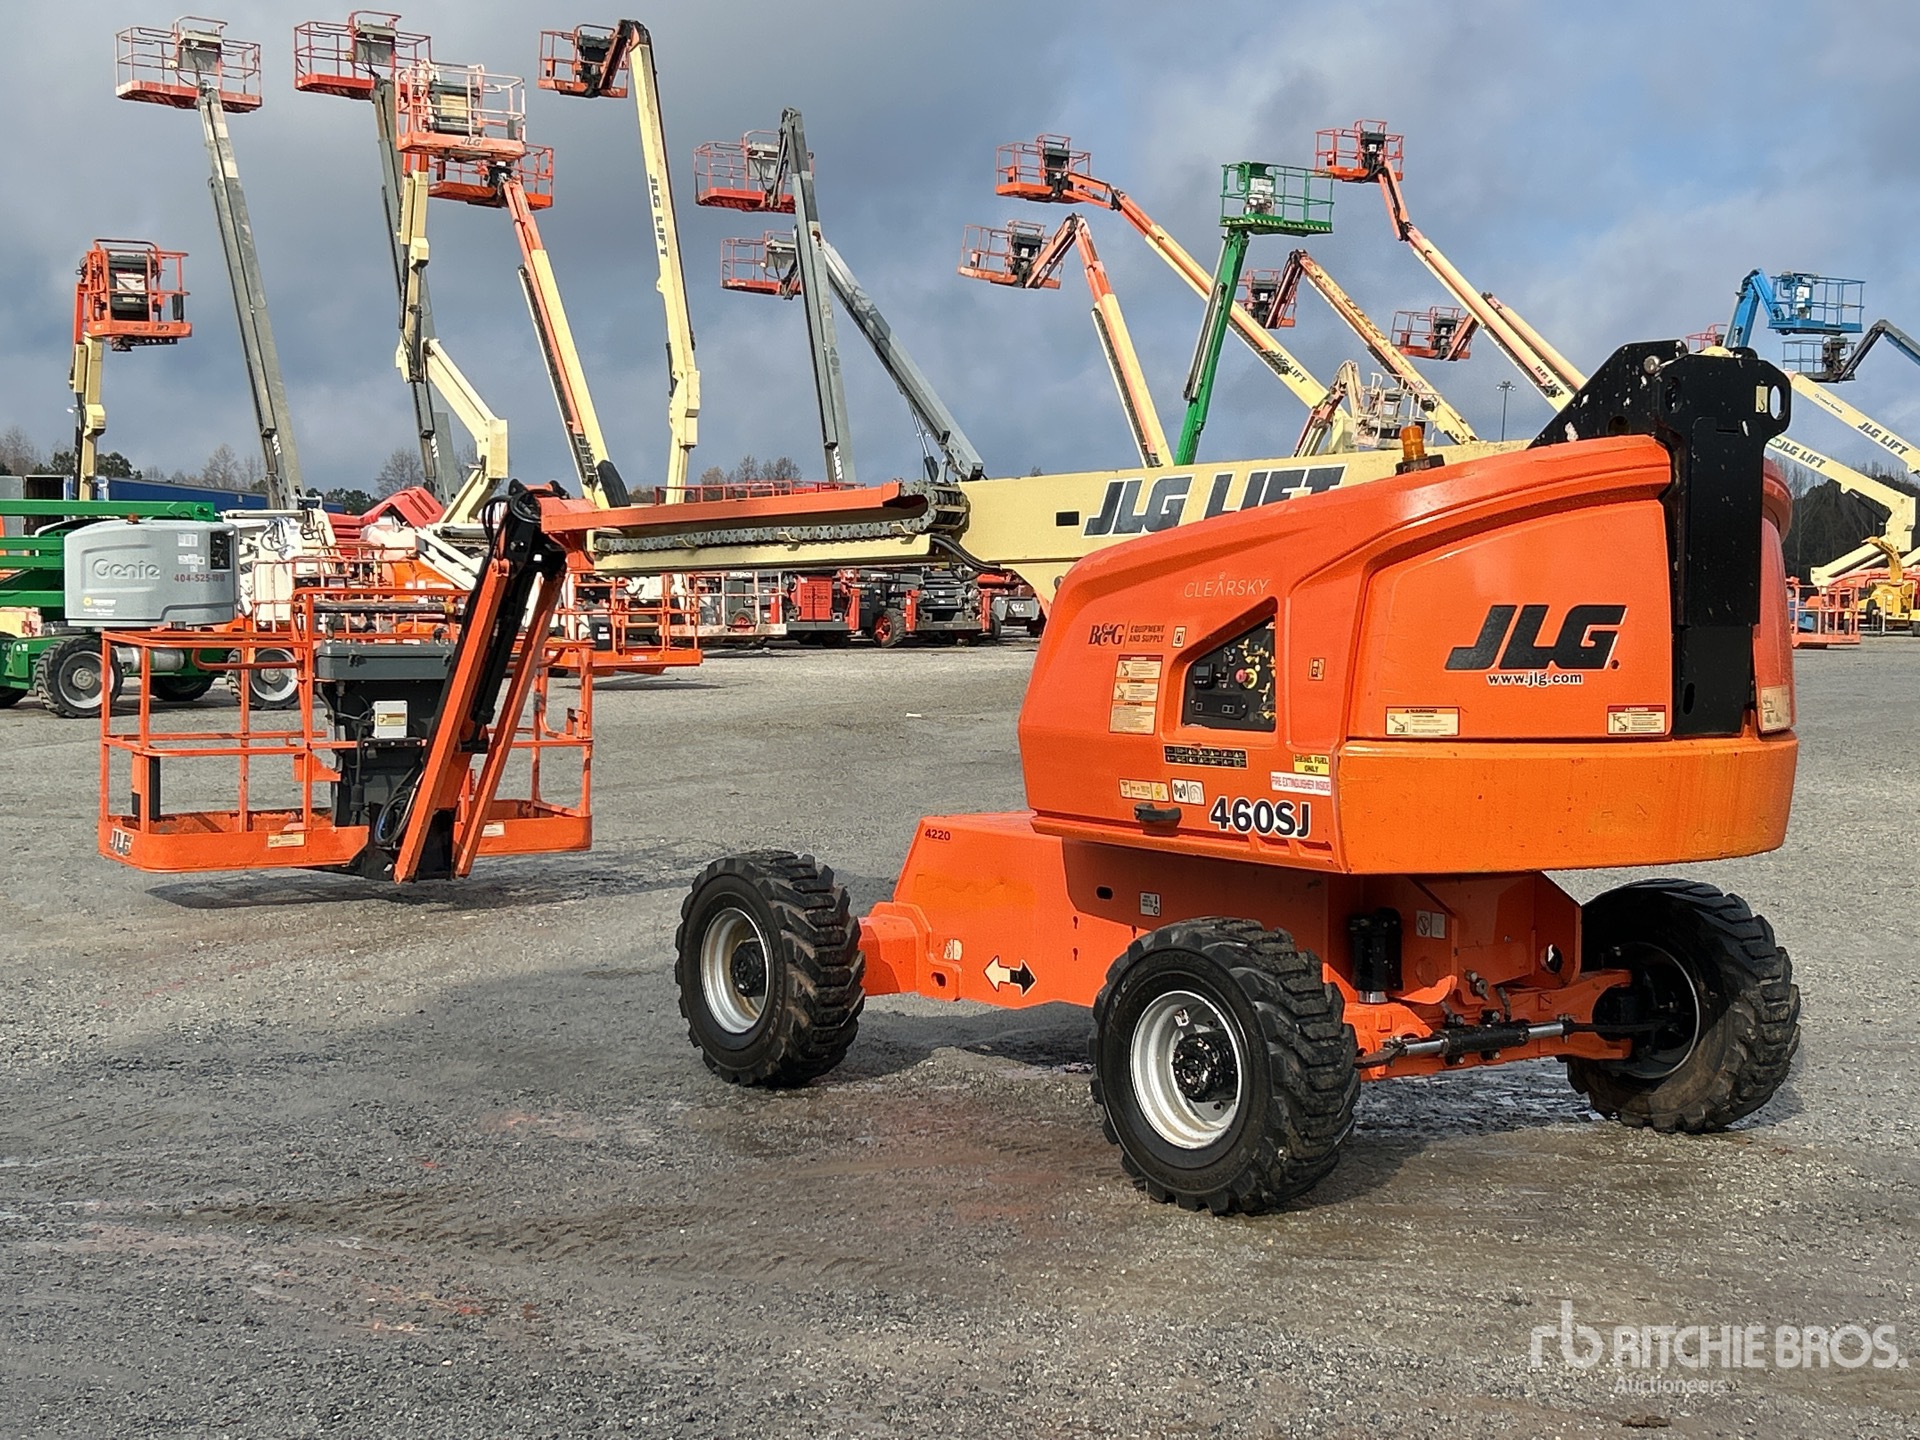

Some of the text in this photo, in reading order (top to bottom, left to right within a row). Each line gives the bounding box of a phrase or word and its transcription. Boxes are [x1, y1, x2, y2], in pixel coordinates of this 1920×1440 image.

[461, 137, 482, 147] JLG
[648, 173, 669, 258] JLG LIFT
[1857, 421, 1910, 456] JLG LIFT
[1780, 441, 1827, 468] JLG LIFT
[1083, 464, 1347, 537] JLG LIFT
[92, 558, 161, 580] Genie
[1184, 578, 1271, 598] CLEARSKY
[1088, 622, 1126, 646] B&G
[1128, 634, 1165, 643] AND SUPPLY
[1130, 624, 1165, 633] EQUIPMENT
[1445, 605, 1627, 670] JLG
[1488, 671, 1582, 686] www.jlg.com
[1304, 765, 1319, 773] ONLY
[1210, 797, 1310, 838] 460SJ
[109, 829, 133, 856] JLG
[925, 829, 951, 841] 4220
